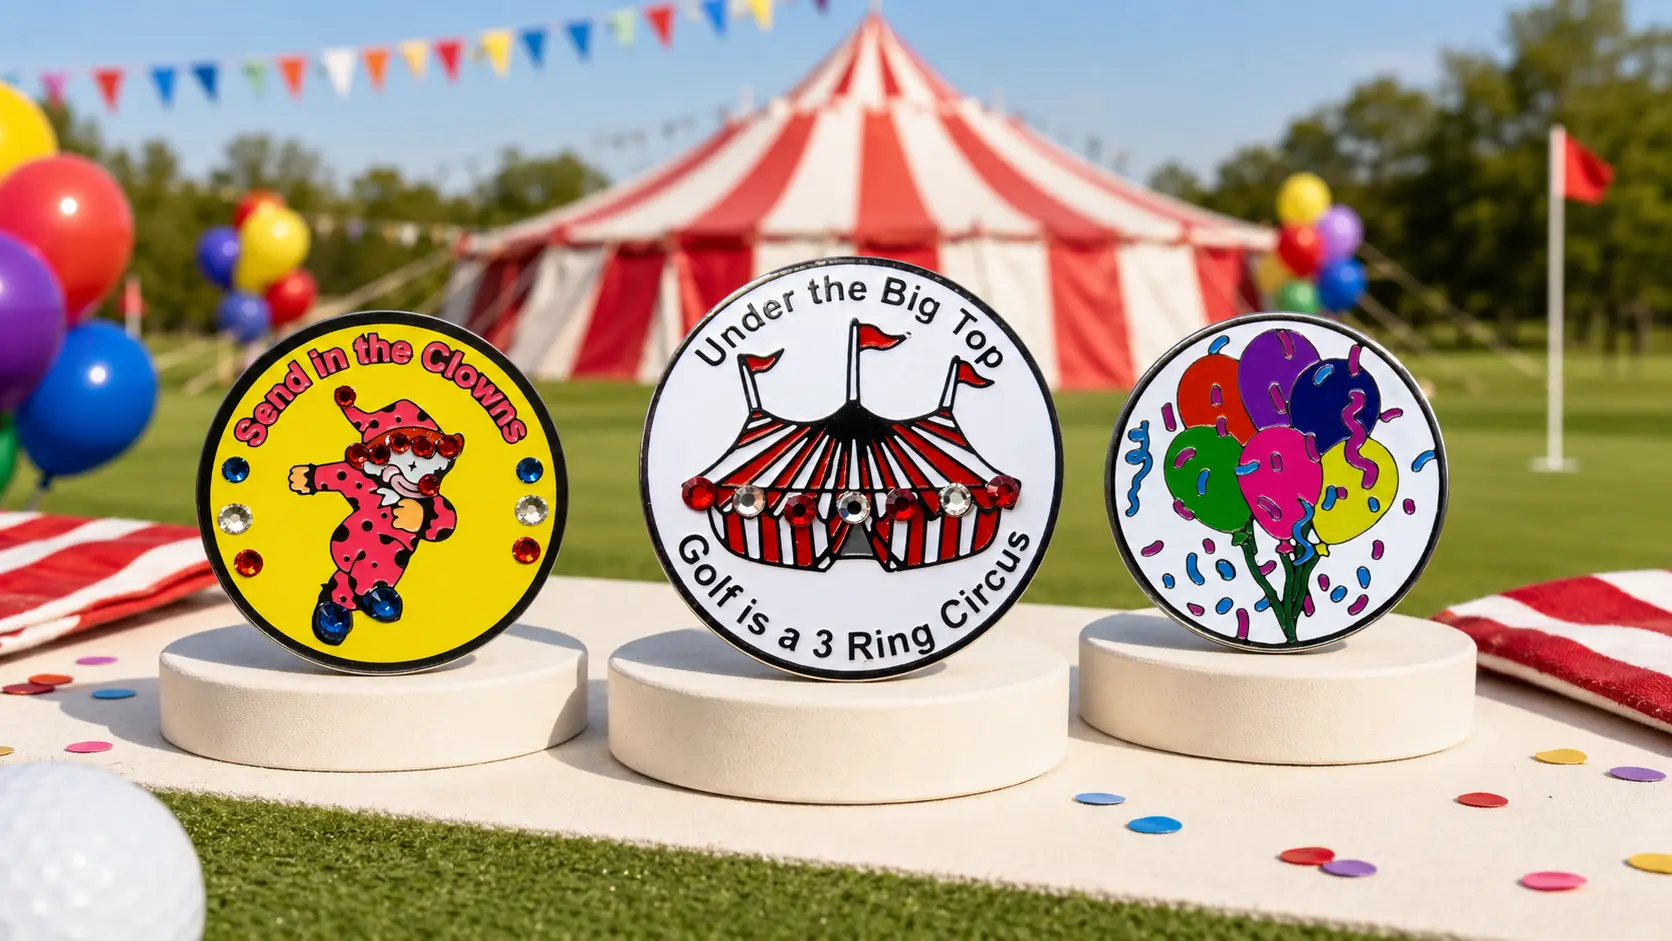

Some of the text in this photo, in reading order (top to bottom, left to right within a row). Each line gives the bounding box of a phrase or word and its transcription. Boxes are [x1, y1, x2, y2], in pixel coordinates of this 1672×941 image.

[695, 275, 1003, 370] Under the Big Top
[234, 333, 527, 447] Send in the Clowns
[678, 529, 1030, 661] Golf is a 3 Ring Circus
